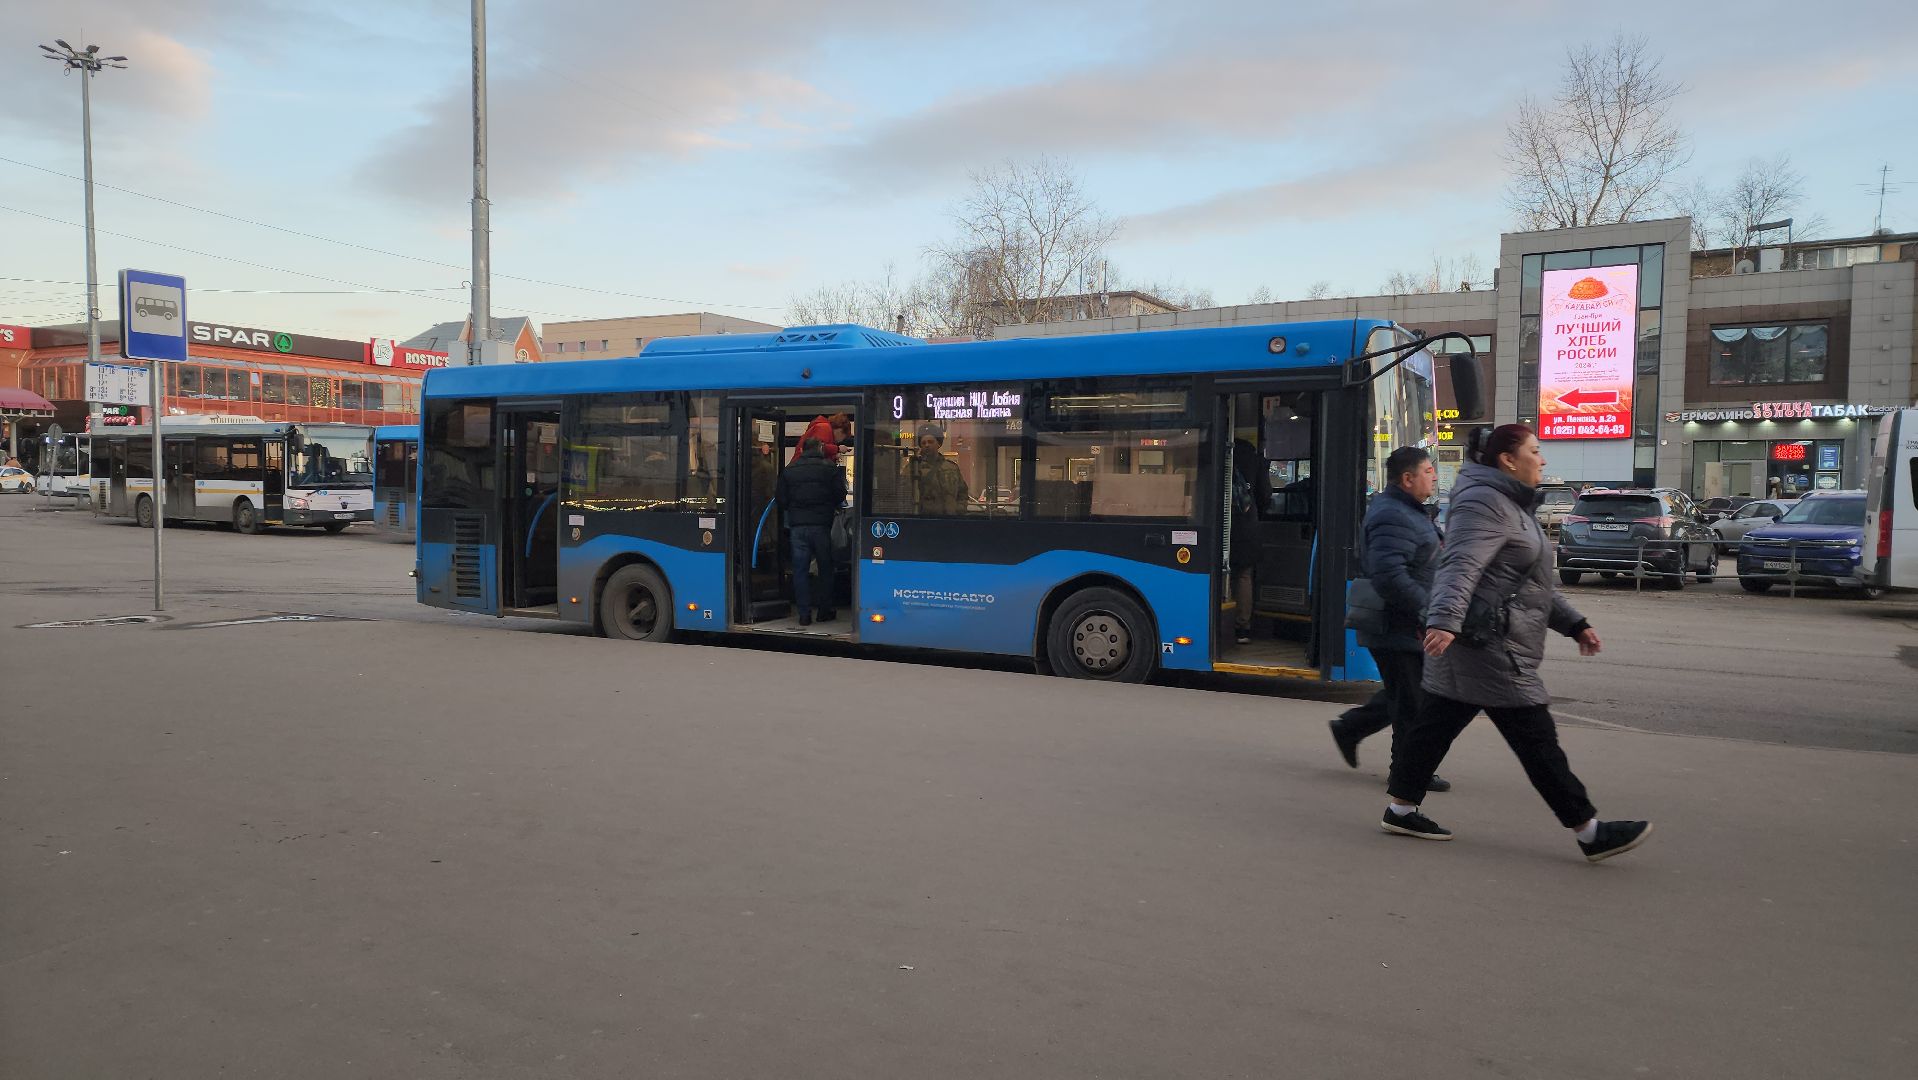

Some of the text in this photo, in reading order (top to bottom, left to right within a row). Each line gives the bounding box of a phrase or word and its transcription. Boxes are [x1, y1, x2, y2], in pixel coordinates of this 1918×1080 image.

[1555, 317, 1621, 334] ЛУЧШИЙ
[193, 325, 269, 348] SPAR
[1568, 335, 1606, 346] ХЛЕБ
[405, 352, 449, 367] ROSTIC'S
[1557, 347, 1616, 360] РОССИИ
[926, 393, 965, 408] Станция
[991, 391, 1020, 406] Лобня
[1753, 402, 1812, 411] СКУПКА
[893, 395, 903, 419] 9
[934, 403, 1012, 419] Красная Поляна
[1812, 404, 1869, 417] ТАБАК
[1681, 410, 1753, 421] ЕРМОЛИНО
[1753, 410, 1812, 419] ЗОЛОТА
[893, 589, 995, 603] МОСТРАНСАВТО
